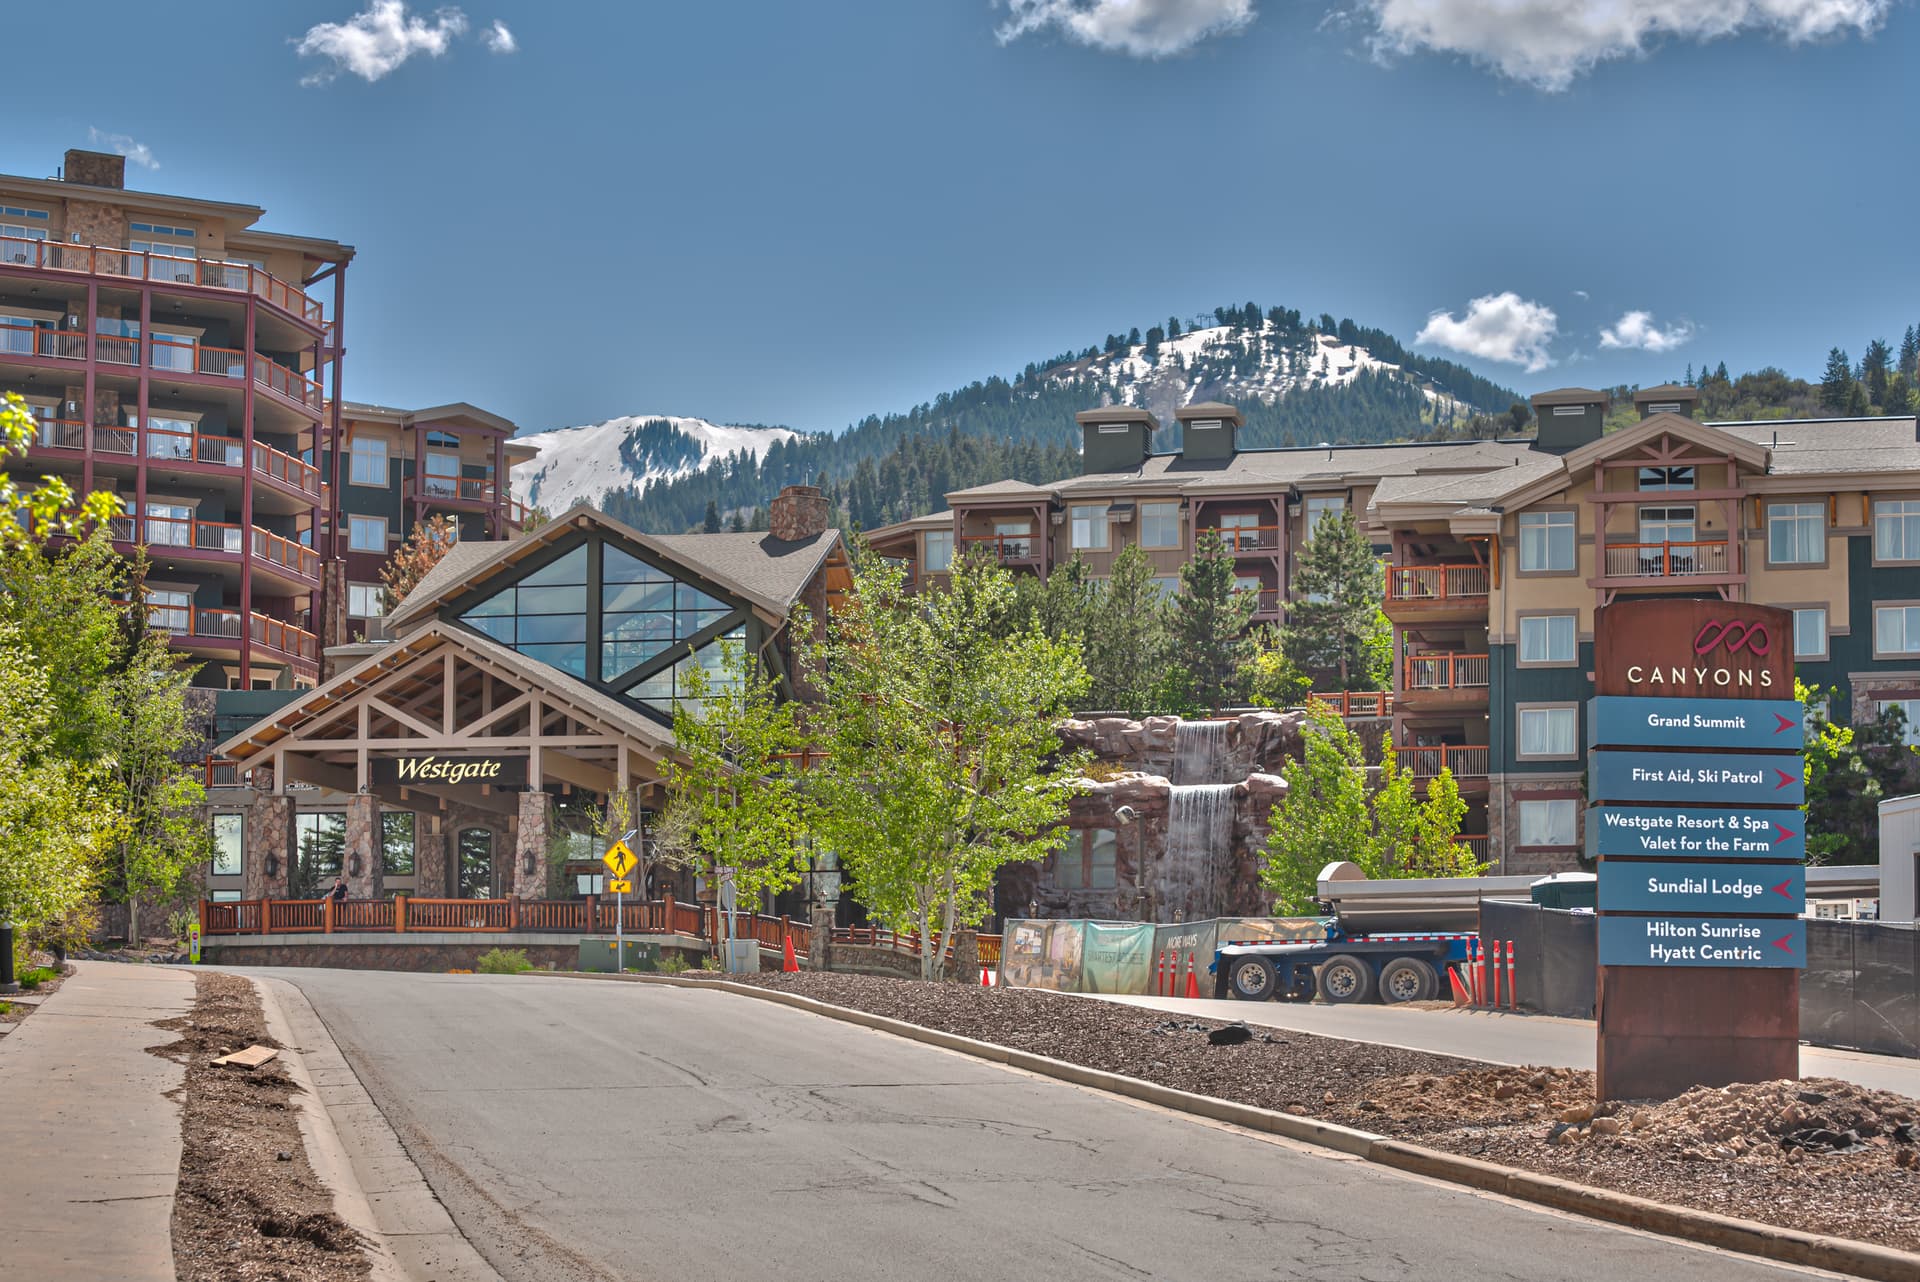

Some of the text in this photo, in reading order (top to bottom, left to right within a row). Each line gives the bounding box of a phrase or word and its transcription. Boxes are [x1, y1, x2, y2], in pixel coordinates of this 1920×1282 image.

[1626, 666, 1773, 688] CANYONS
[1647, 713, 1746, 729] Grand Summit
[397, 755, 502, 785] Westgate
[1632, 768, 1763, 784] First Aid, Ski Patrol
[1604, 813, 1769, 833] Westgate Resort & Spa
[1640, 835, 1770, 852] Valet for the Farm
[1648, 877, 1763, 899] Sundial Lodge
[1647, 921, 1761, 938] Hilton Sunrise
[1650, 943, 1762, 963] Hyatt Centric
